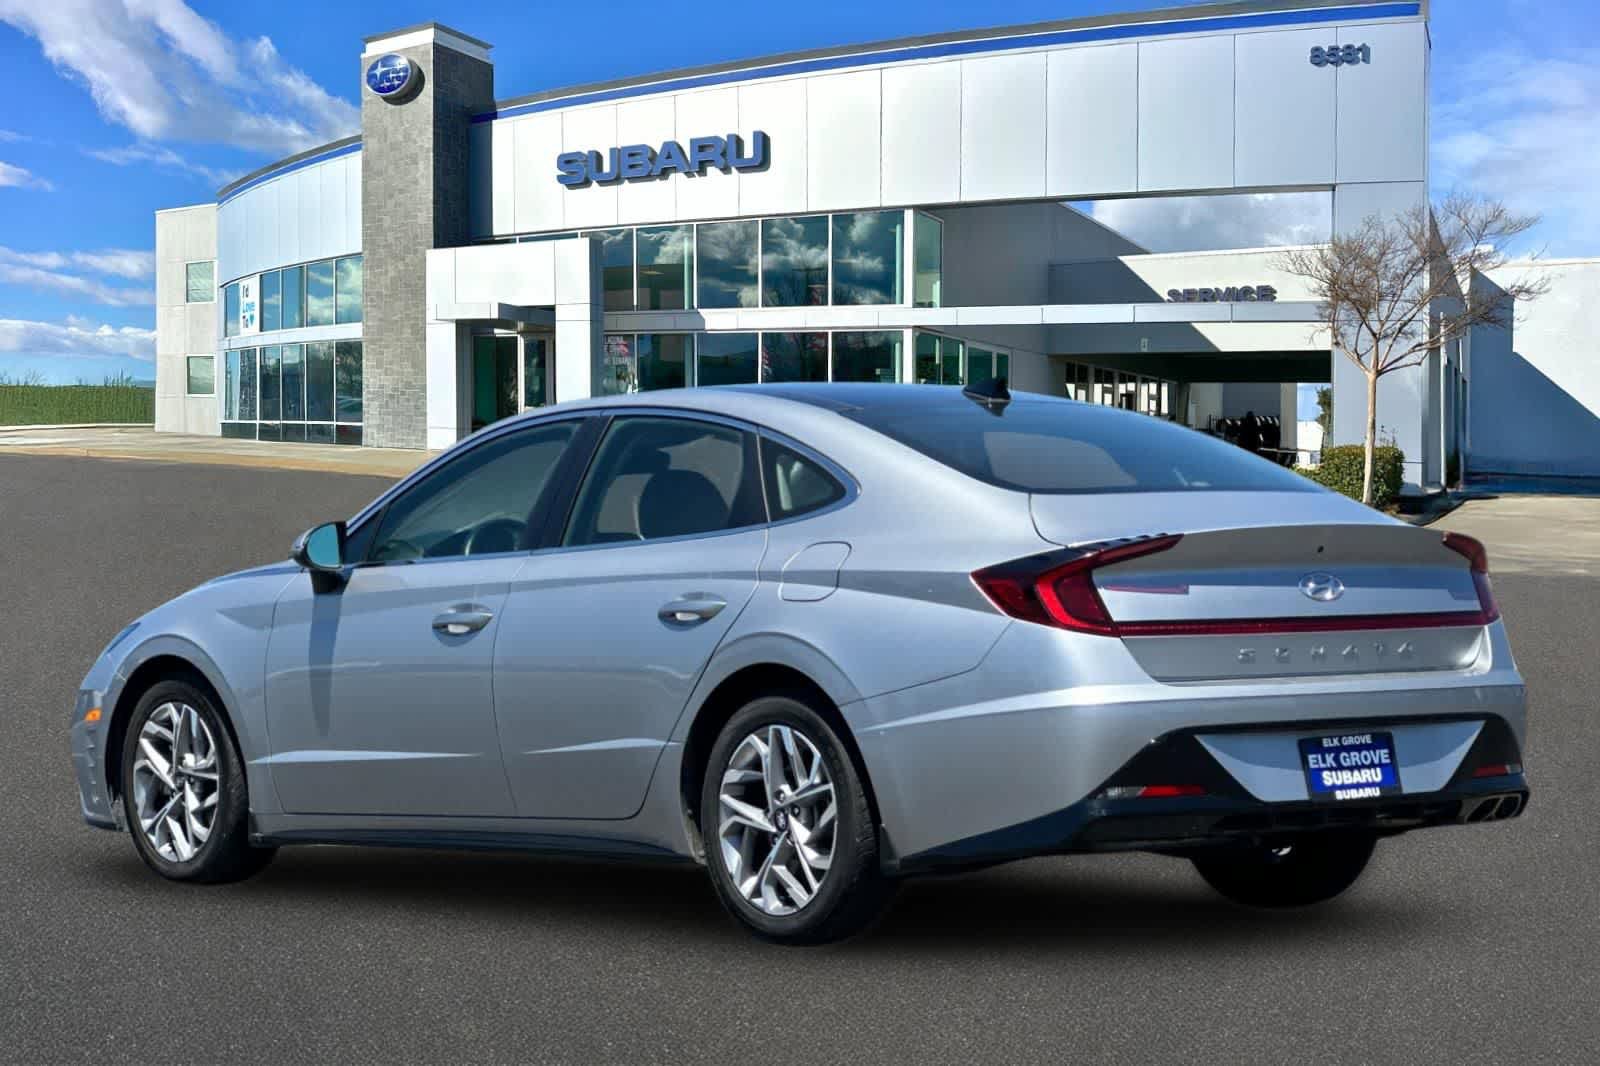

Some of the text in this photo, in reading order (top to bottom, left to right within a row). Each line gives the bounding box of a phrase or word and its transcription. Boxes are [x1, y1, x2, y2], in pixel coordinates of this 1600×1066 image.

[556, 130, 770, 190] SUBARU
[1167, 285, 1277, 302] SERVICE
[1322, 734, 1372, 747] ELK GROVE
[1308, 749, 1391, 768] ELK GROVE
[1322, 768, 1382, 786] SUBARU
[1335, 787, 1380, 800] SUBARU
